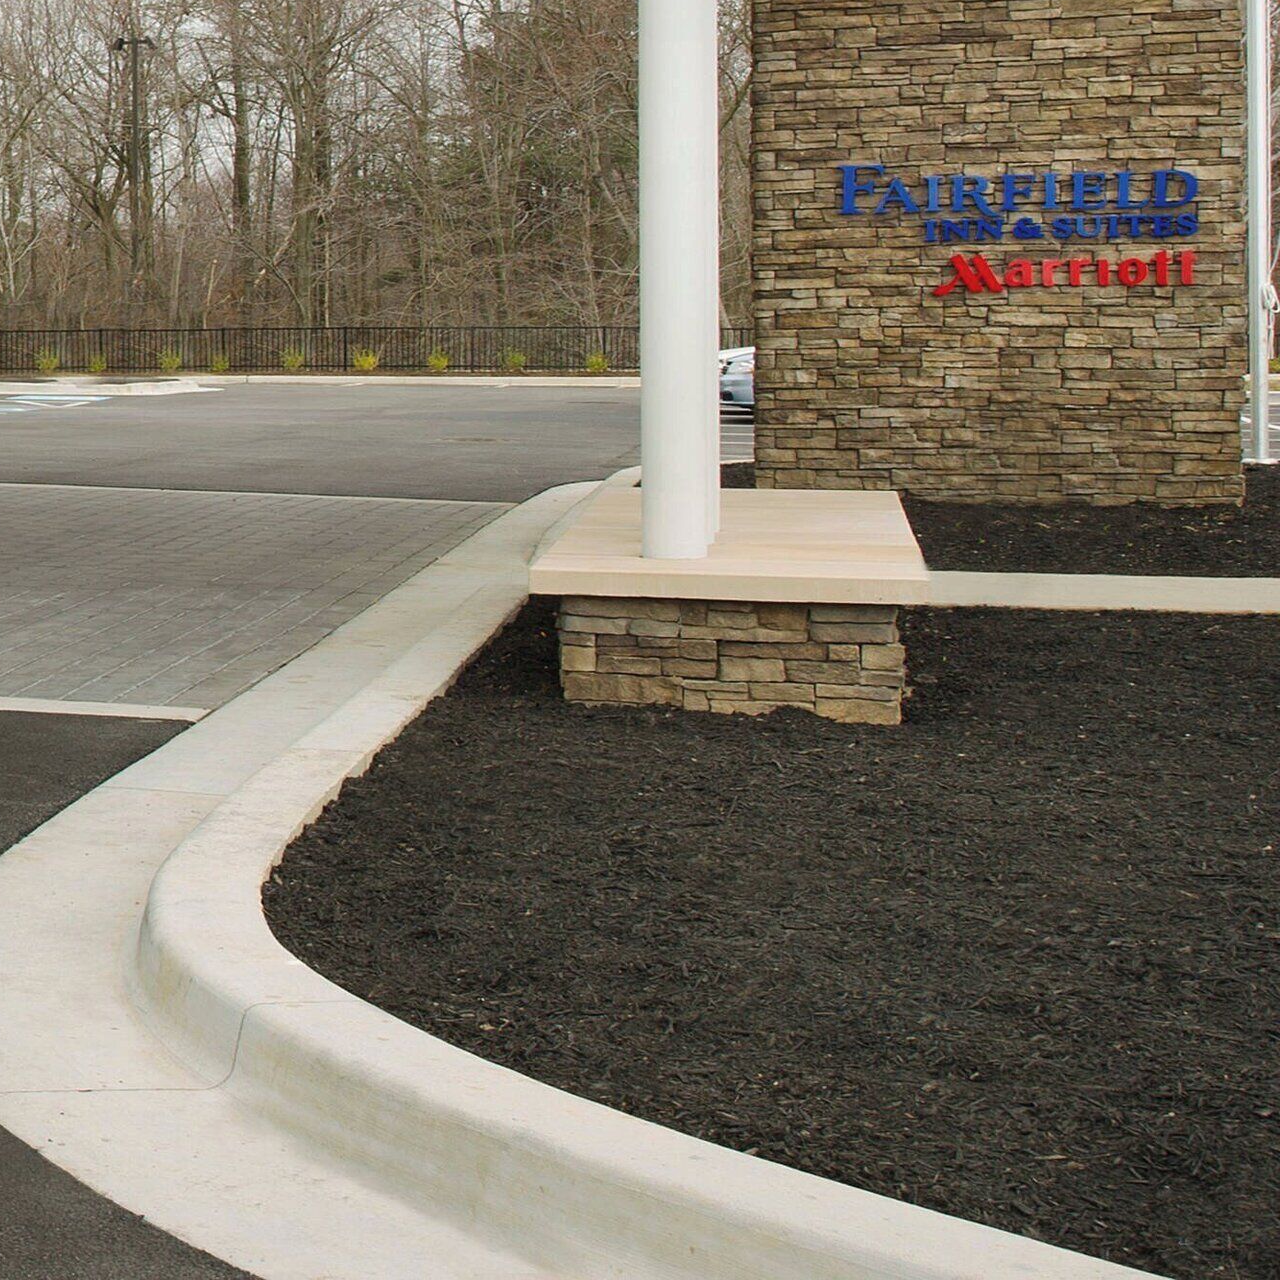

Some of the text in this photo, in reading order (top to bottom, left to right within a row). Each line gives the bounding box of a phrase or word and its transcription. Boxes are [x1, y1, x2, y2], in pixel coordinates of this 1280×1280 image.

[839, 163, 1200, 218] FAIRFIELD
[924, 213, 1200, 243] INN & SUITES
[933, 249, 1197, 297] Marriott
